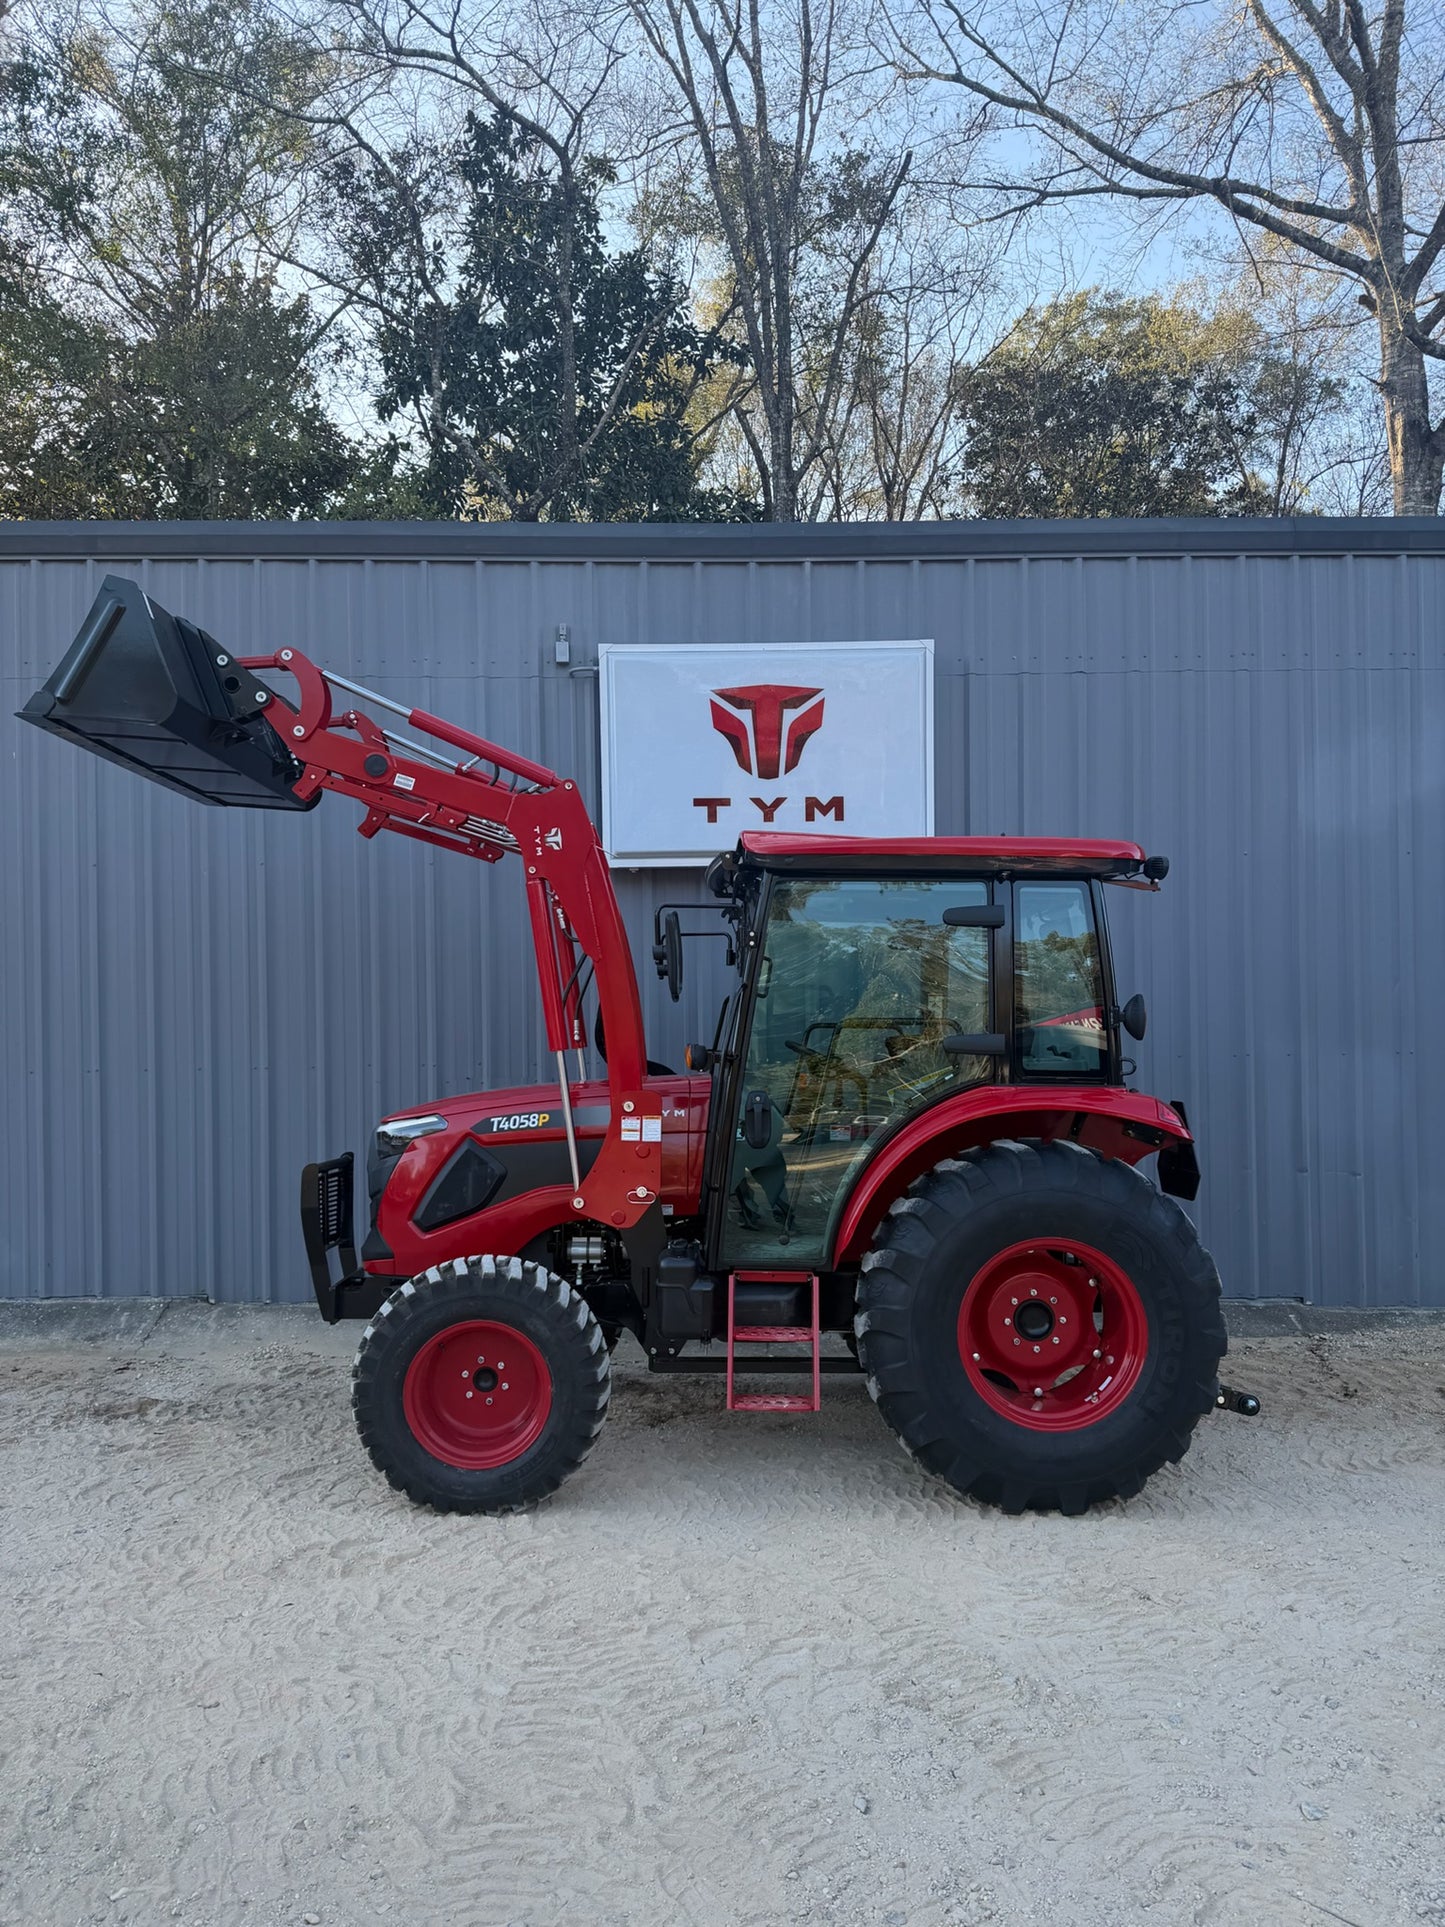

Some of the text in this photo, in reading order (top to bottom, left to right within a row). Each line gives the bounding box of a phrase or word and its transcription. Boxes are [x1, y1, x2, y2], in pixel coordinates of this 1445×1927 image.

[692, 796, 845, 824] TYM
[533, 825, 543, 856] TYM
[490, 1113, 550, 1132] T4058P
[662, 1109, 686, 1118] YM
